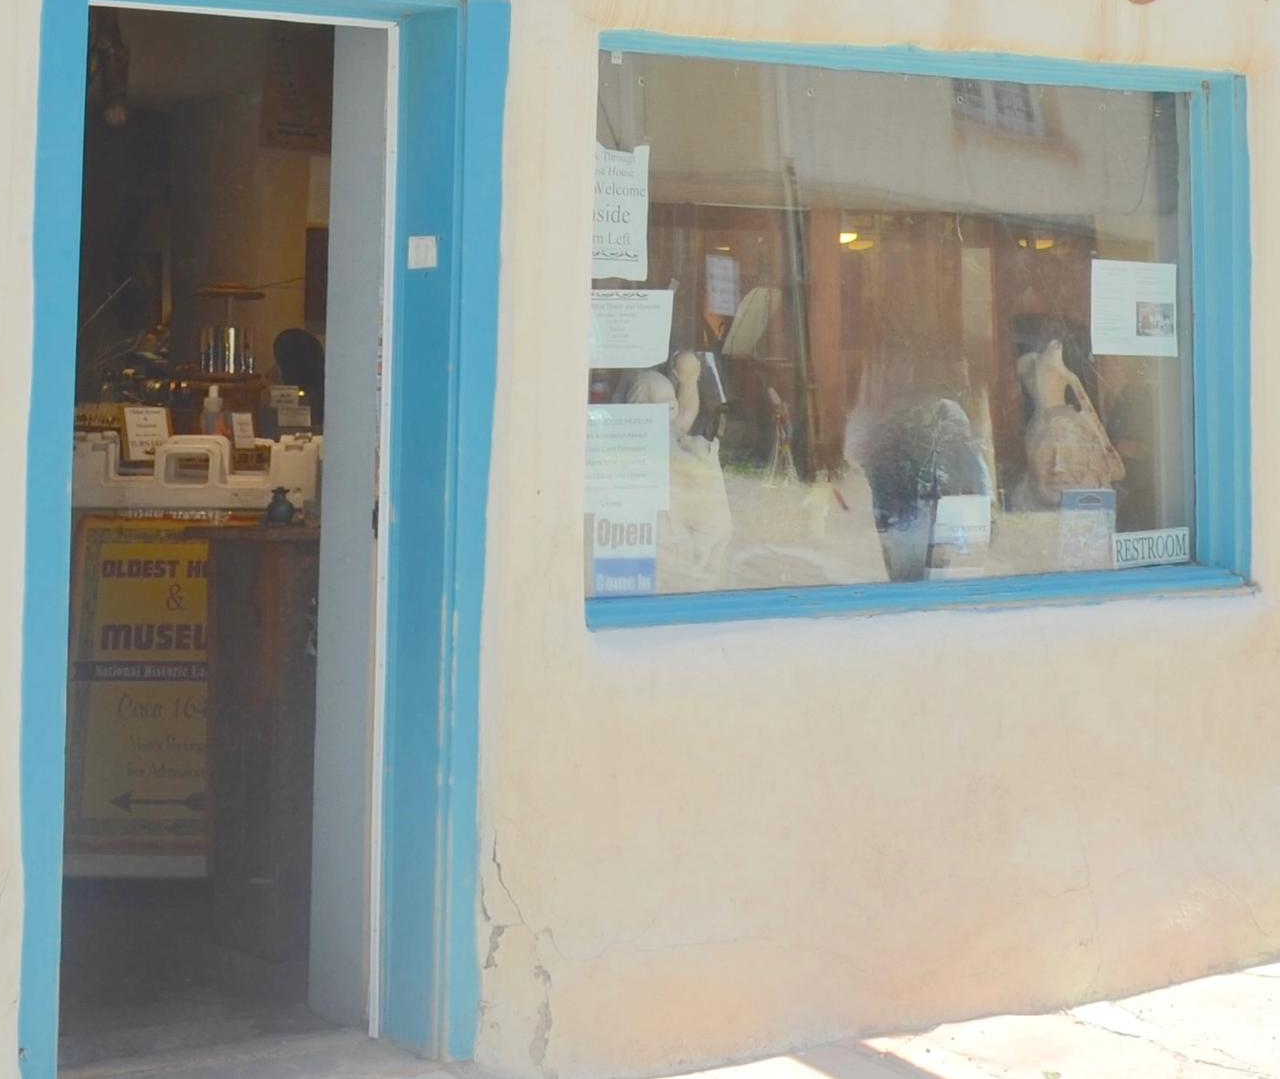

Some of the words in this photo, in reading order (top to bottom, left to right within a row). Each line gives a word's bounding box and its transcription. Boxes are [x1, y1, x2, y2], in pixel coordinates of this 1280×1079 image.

[593, 182, 646, 198] Welcome
[608, 233, 631, 246] Left
[597, 518, 653, 549] Open
[1115, 533, 1187, 563] RESTROOM
[102, 560, 180, 578] OLDEST
[95, 663, 141, 678] National
